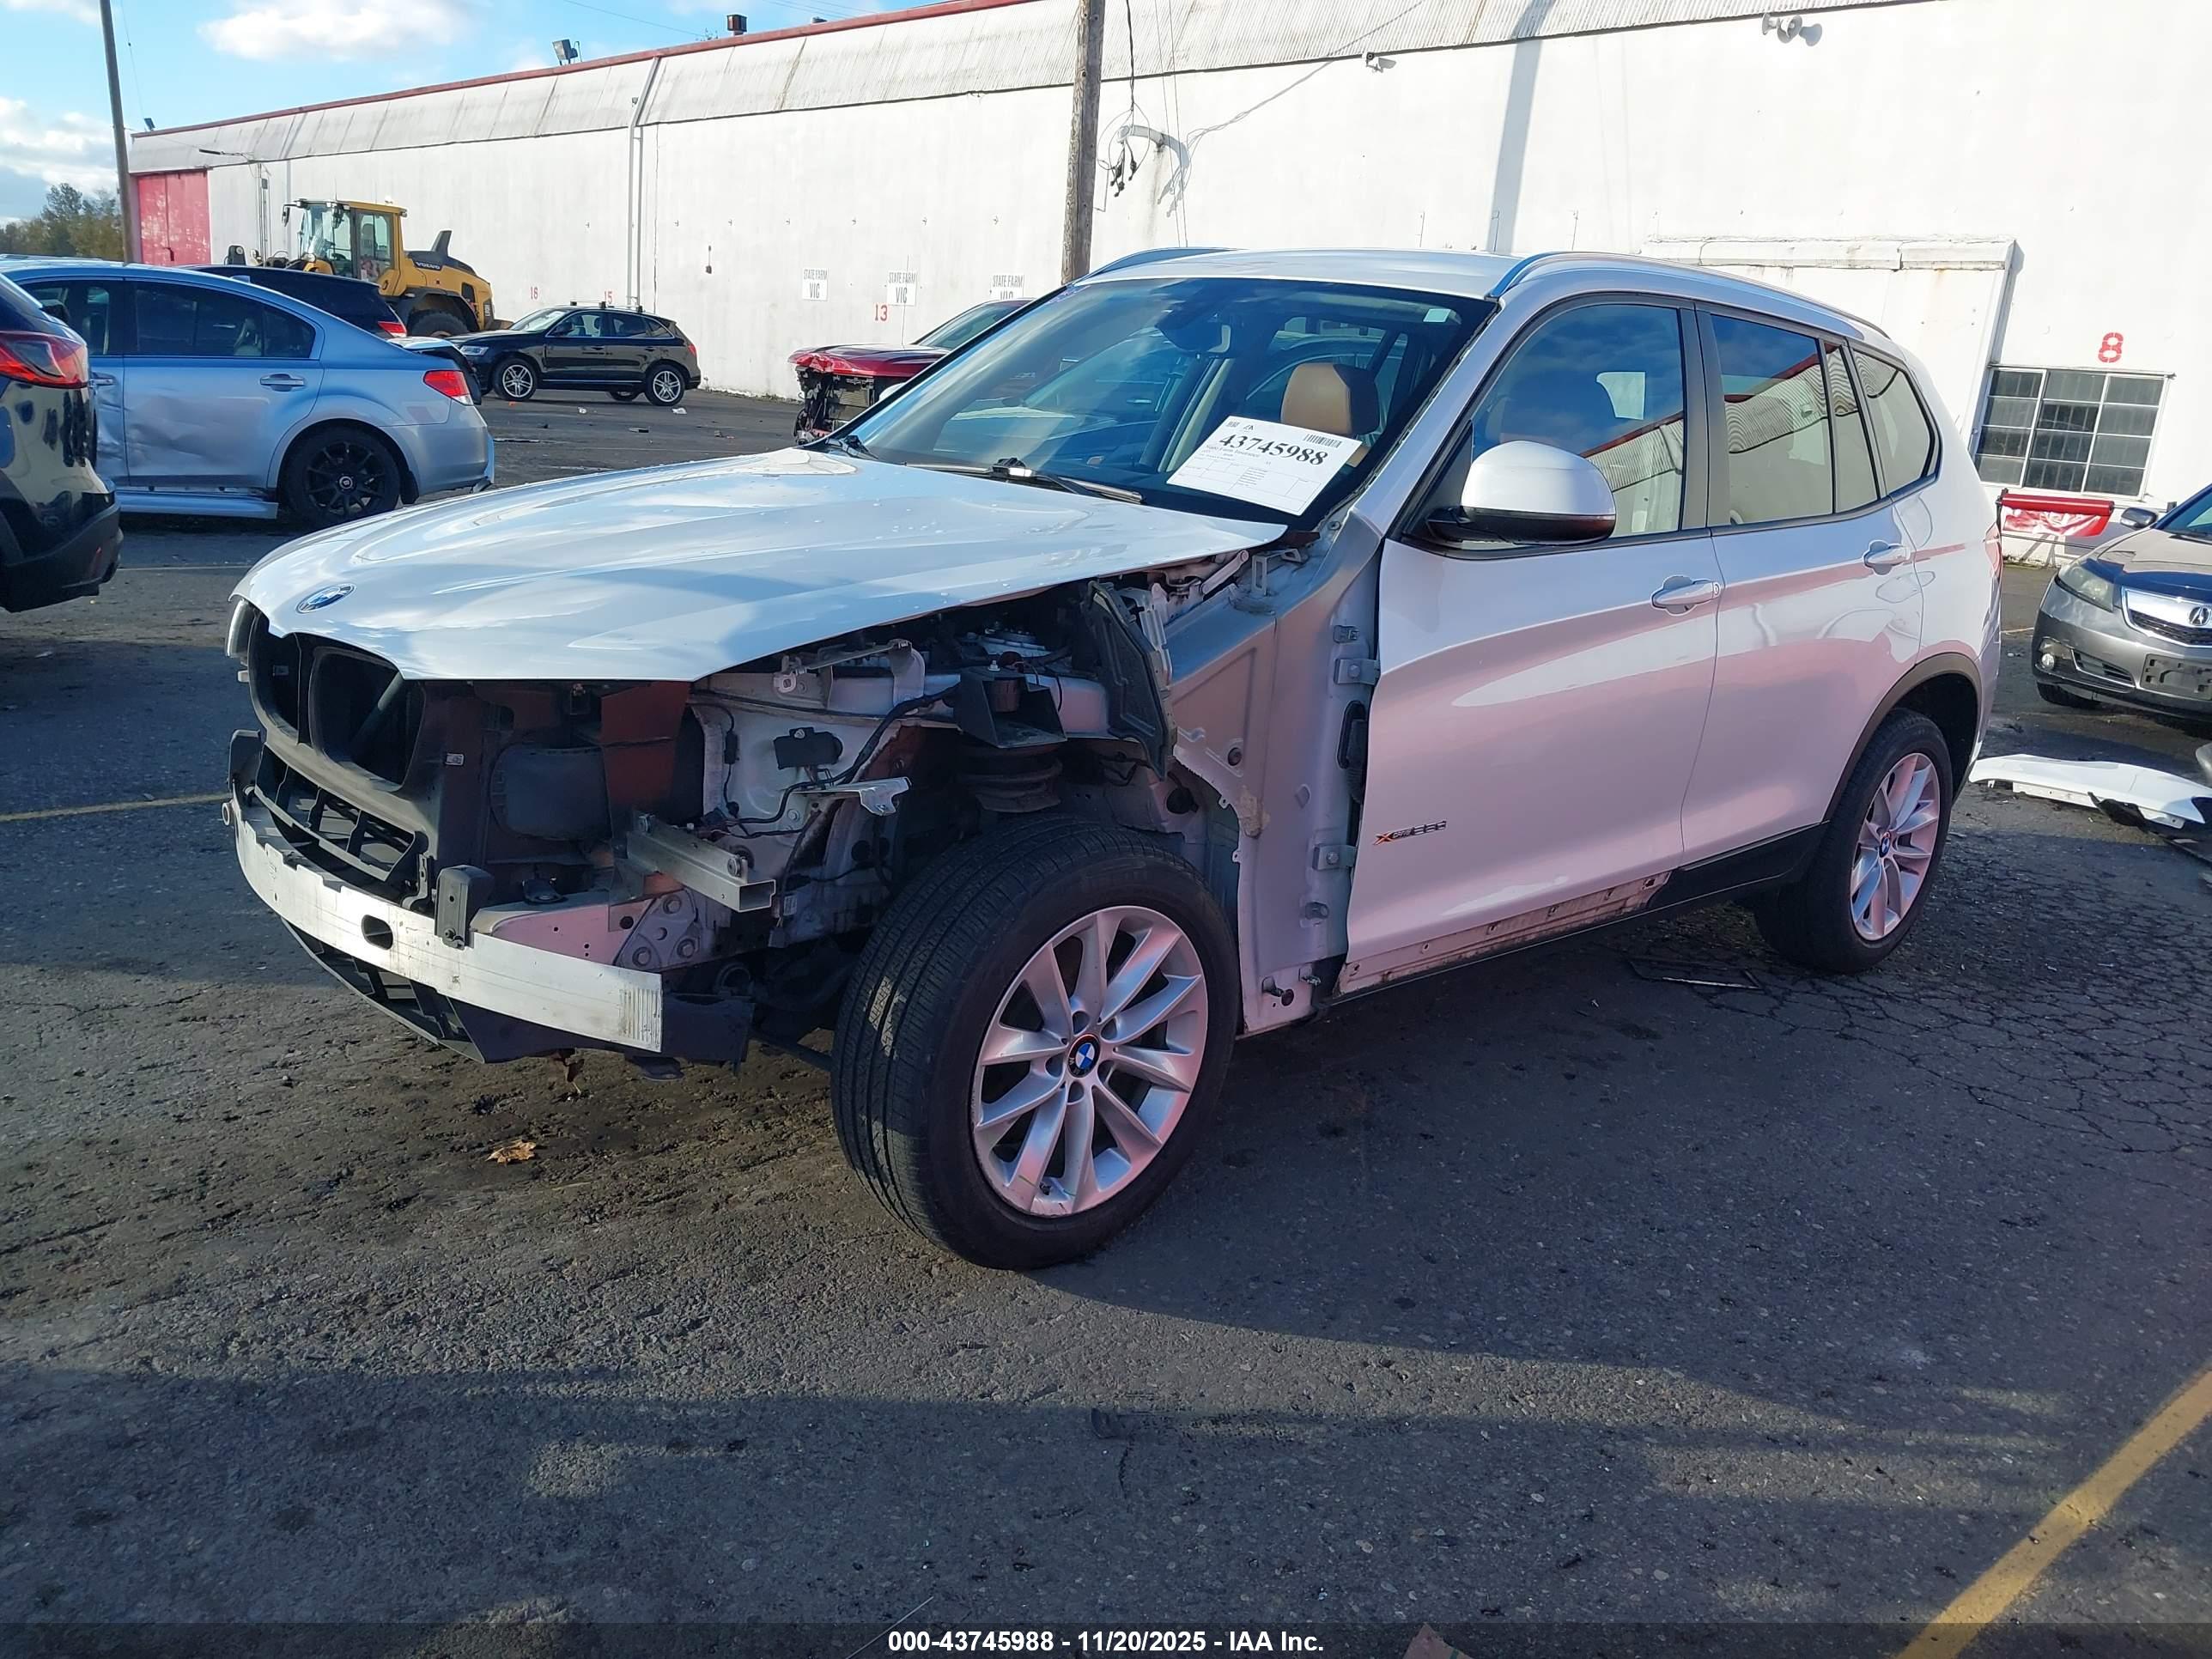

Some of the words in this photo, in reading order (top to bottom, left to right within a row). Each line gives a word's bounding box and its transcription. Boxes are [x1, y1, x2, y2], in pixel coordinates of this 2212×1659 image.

[416, 261, 441, 270] VOLVO
[804, 269, 815, 281] STATE
[816, 269, 828, 282] FARM
[889, 271, 902, 284] STATE
[902, 271, 916, 285] FARM
[993, 275, 1006, 288] STATE
[1007, 275, 1023, 289] FARM
[604, 290, 613, 305] 15
[810, 283, 820, 299] VIC
[896, 287, 908, 304] VIC
[874, 303, 888, 322] 13
[2098, 332, 2124, 362] 8
[1218, 434, 1328, 465] 43745988
